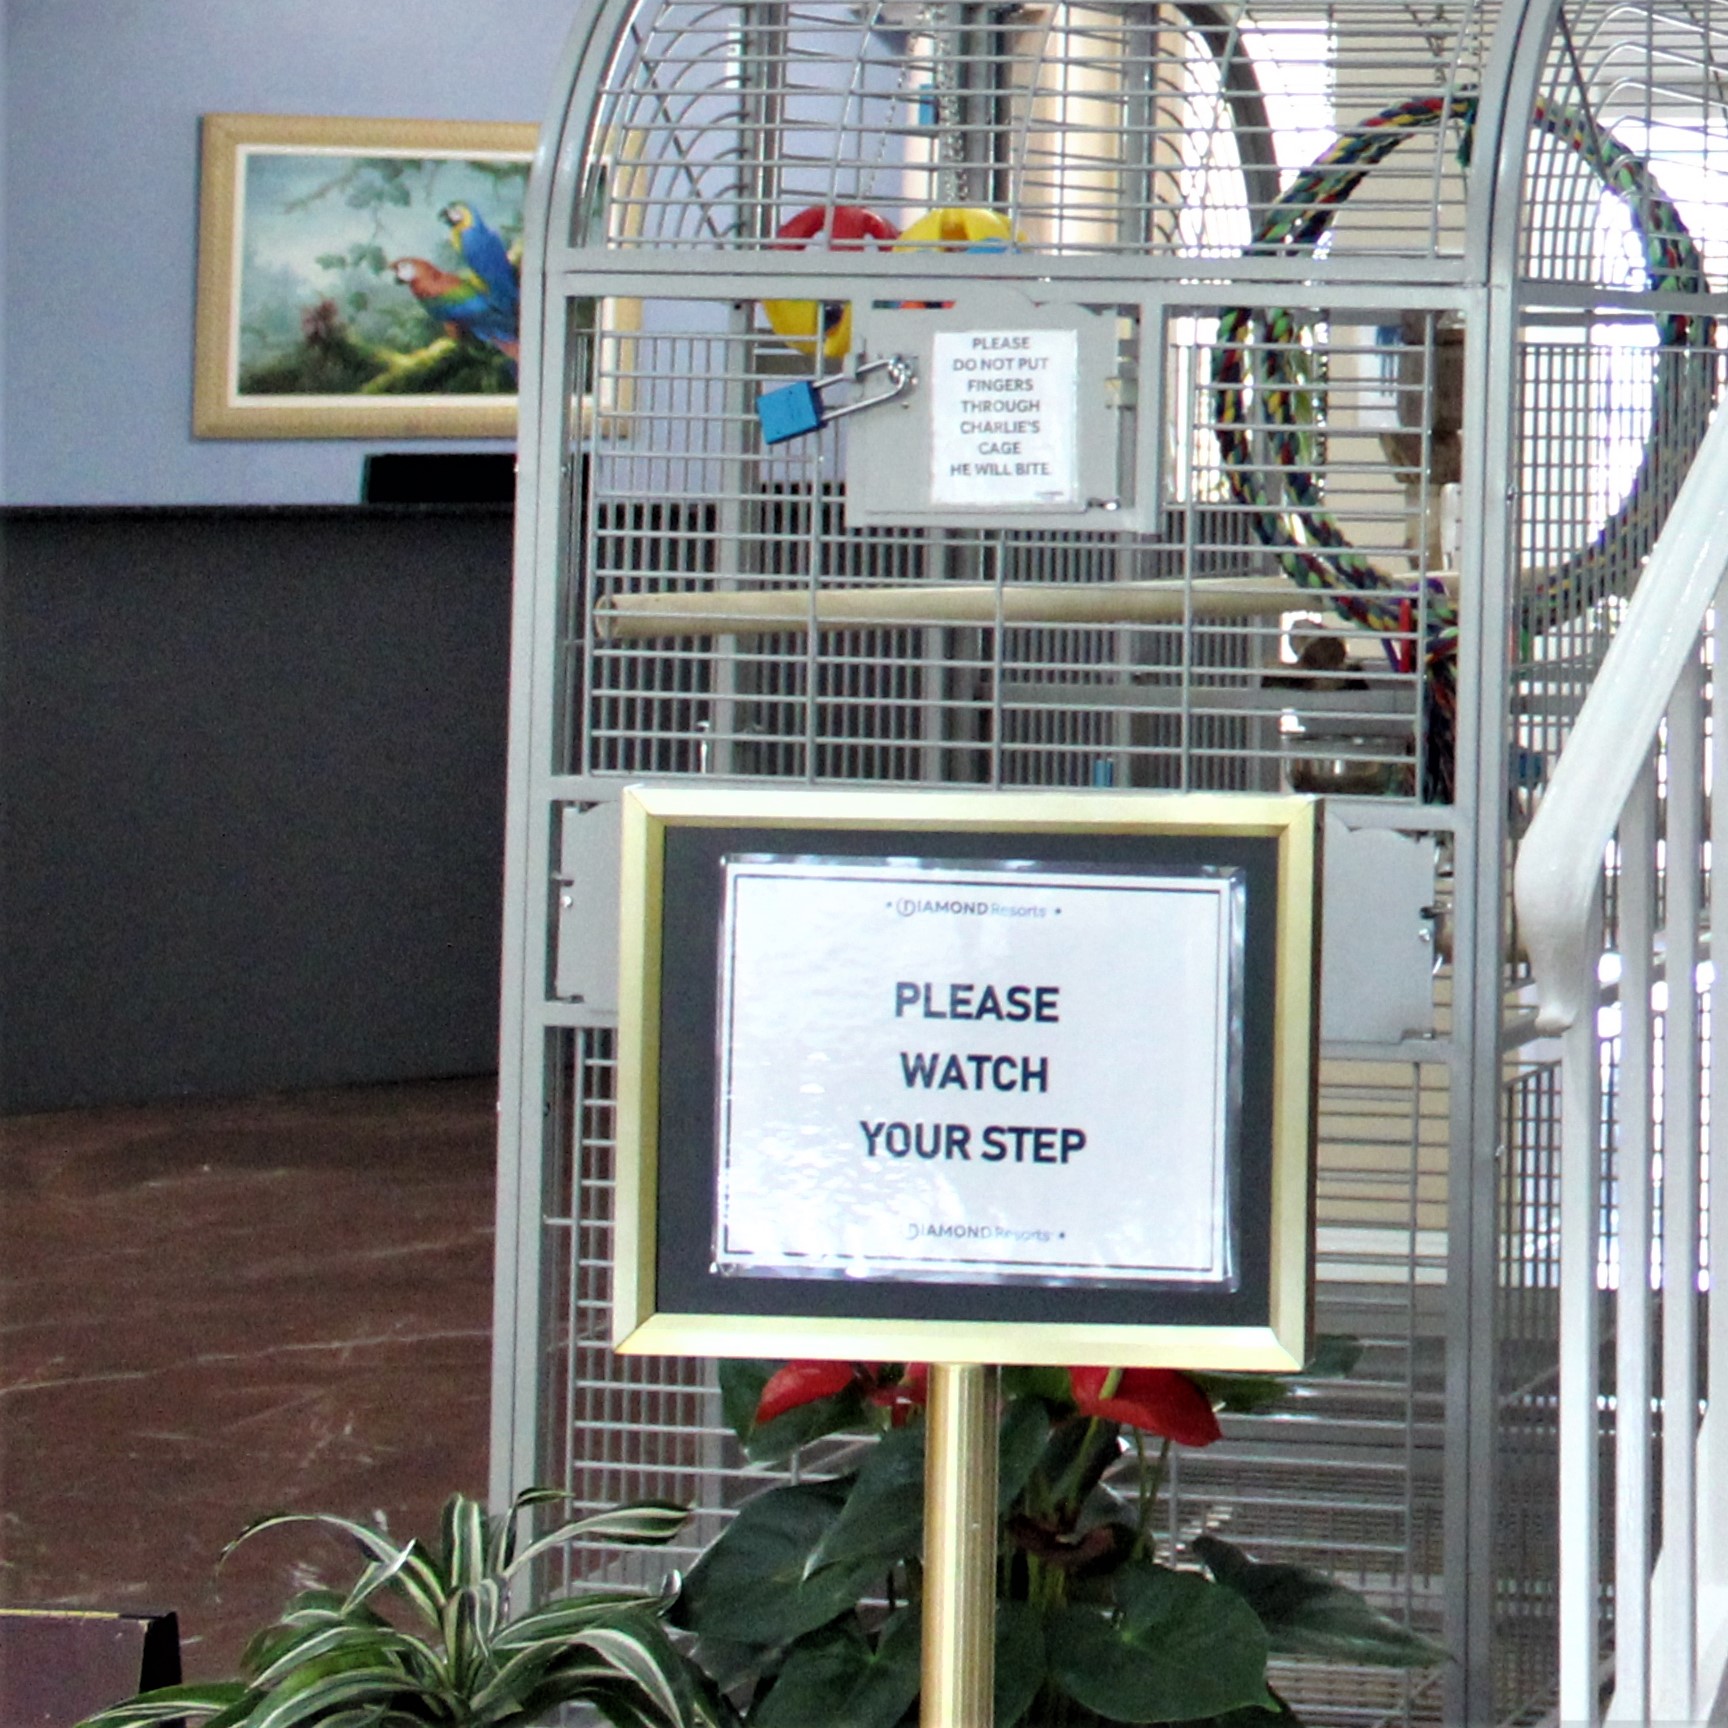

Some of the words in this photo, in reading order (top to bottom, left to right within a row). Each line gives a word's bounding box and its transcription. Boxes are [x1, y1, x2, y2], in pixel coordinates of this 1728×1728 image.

[972, 337, 1030, 350] PLEASE
[953, 358, 978, 371] DO
[981, 358, 1015, 371] NOT
[1018, 358, 1049, 370] PUT
[968, 379, 1033, 392] FINGERS
[961, 400, 1040, 413] THROUGH
[960, 421, 1040, 434] CHARLIE'S
[979, 442, 1021, 455] CAGE
[951, 463, 971, 476] HE
[974, 463, 1012, 476] WILL
[1015, 463, 1049, 476] BITE
[896, 898, 988, 917] DIAMOND
[991, 903, 1047, 918] Resorts
[895, 982, 1060, 1024] PLEASE
[901, 1052, 1048, 1093] WATCH
[860, 1121, 971, 1162] YOUR
[980, 1124, 1087, 1164] STEP
